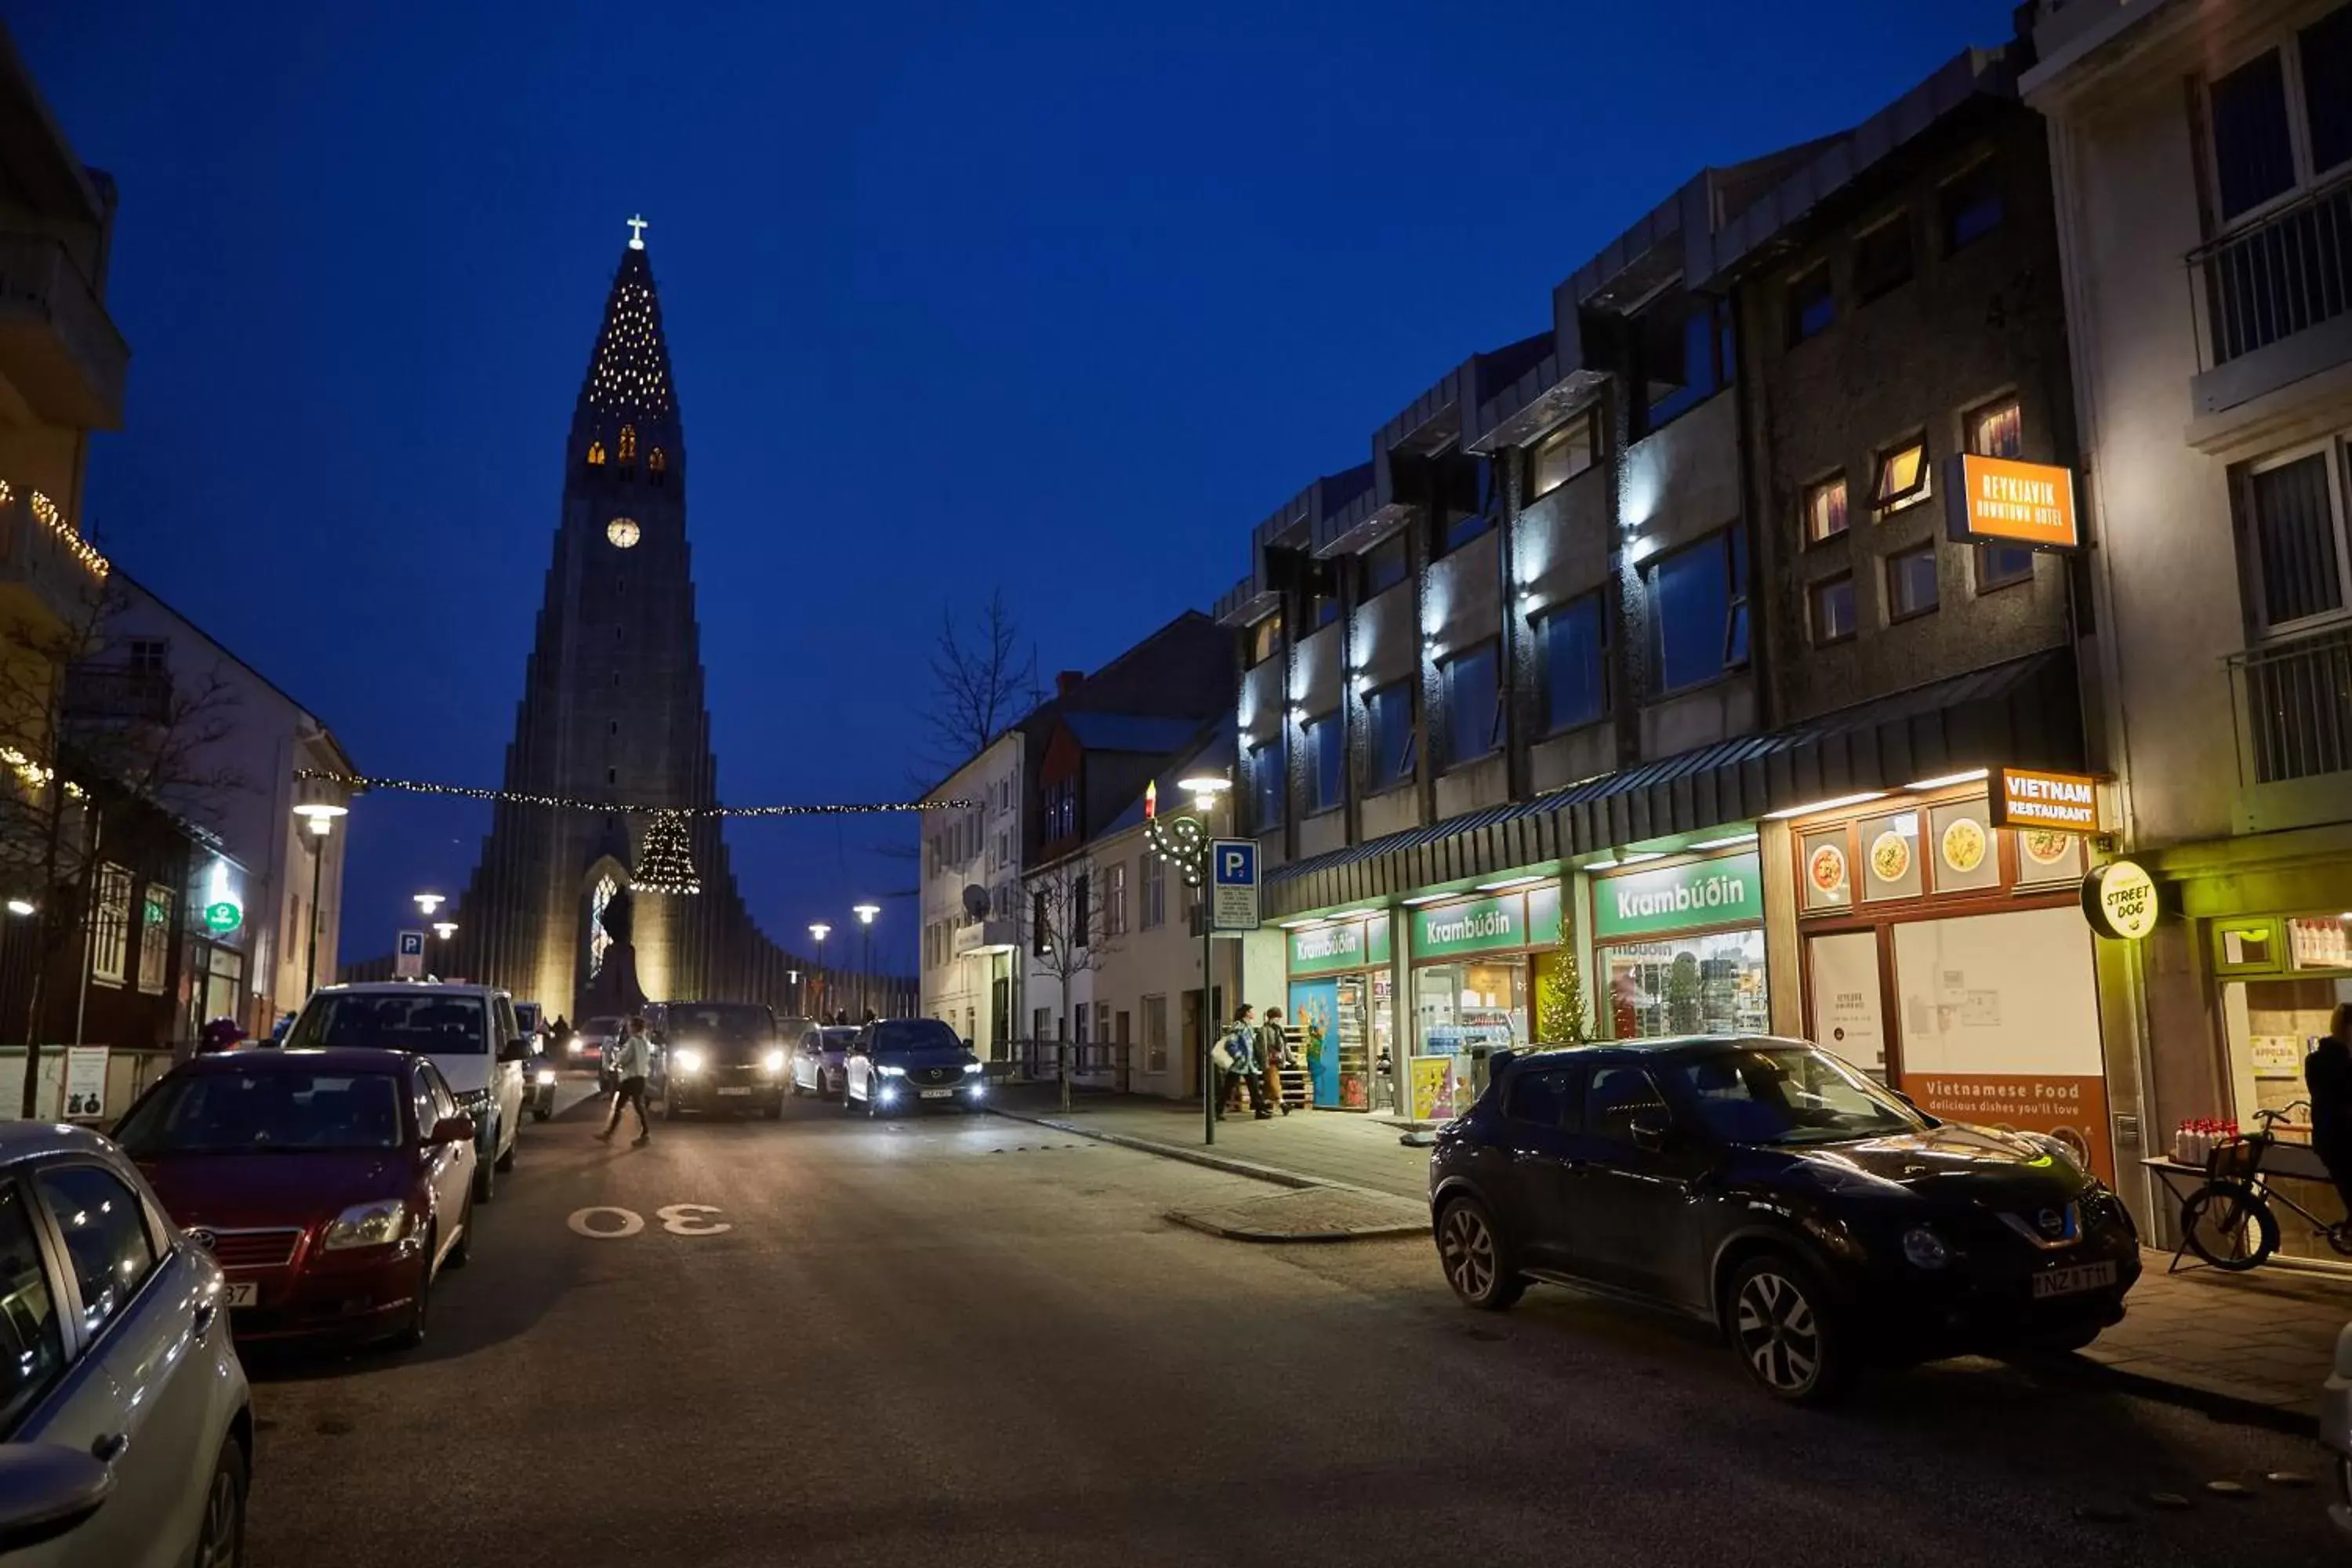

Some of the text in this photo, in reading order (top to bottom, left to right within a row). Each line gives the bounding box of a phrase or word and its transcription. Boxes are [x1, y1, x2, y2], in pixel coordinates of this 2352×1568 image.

[1977, 499, 2063, 526] DOWNTOWN HOTEL
[2006, 776, 2092, 803] VIETNAM
[2008, 800, 2092, 822] RESTAURANT
[1225, 852, 1244, 877] P
[1617, 876, 1744, 920] Krambúðin
[2107, 884, 2151, 906] STREET
[2118, 902, 2144, 918] DOG
[1426, 911, 1510, 945] Krambúðin
[1297, 931, 1356, 961] Krambúðin
[1926, 1081, 2080, 1098] Vietnamese Food
[1929, 1100, 2080, 1116] delicious dishes you'll love
